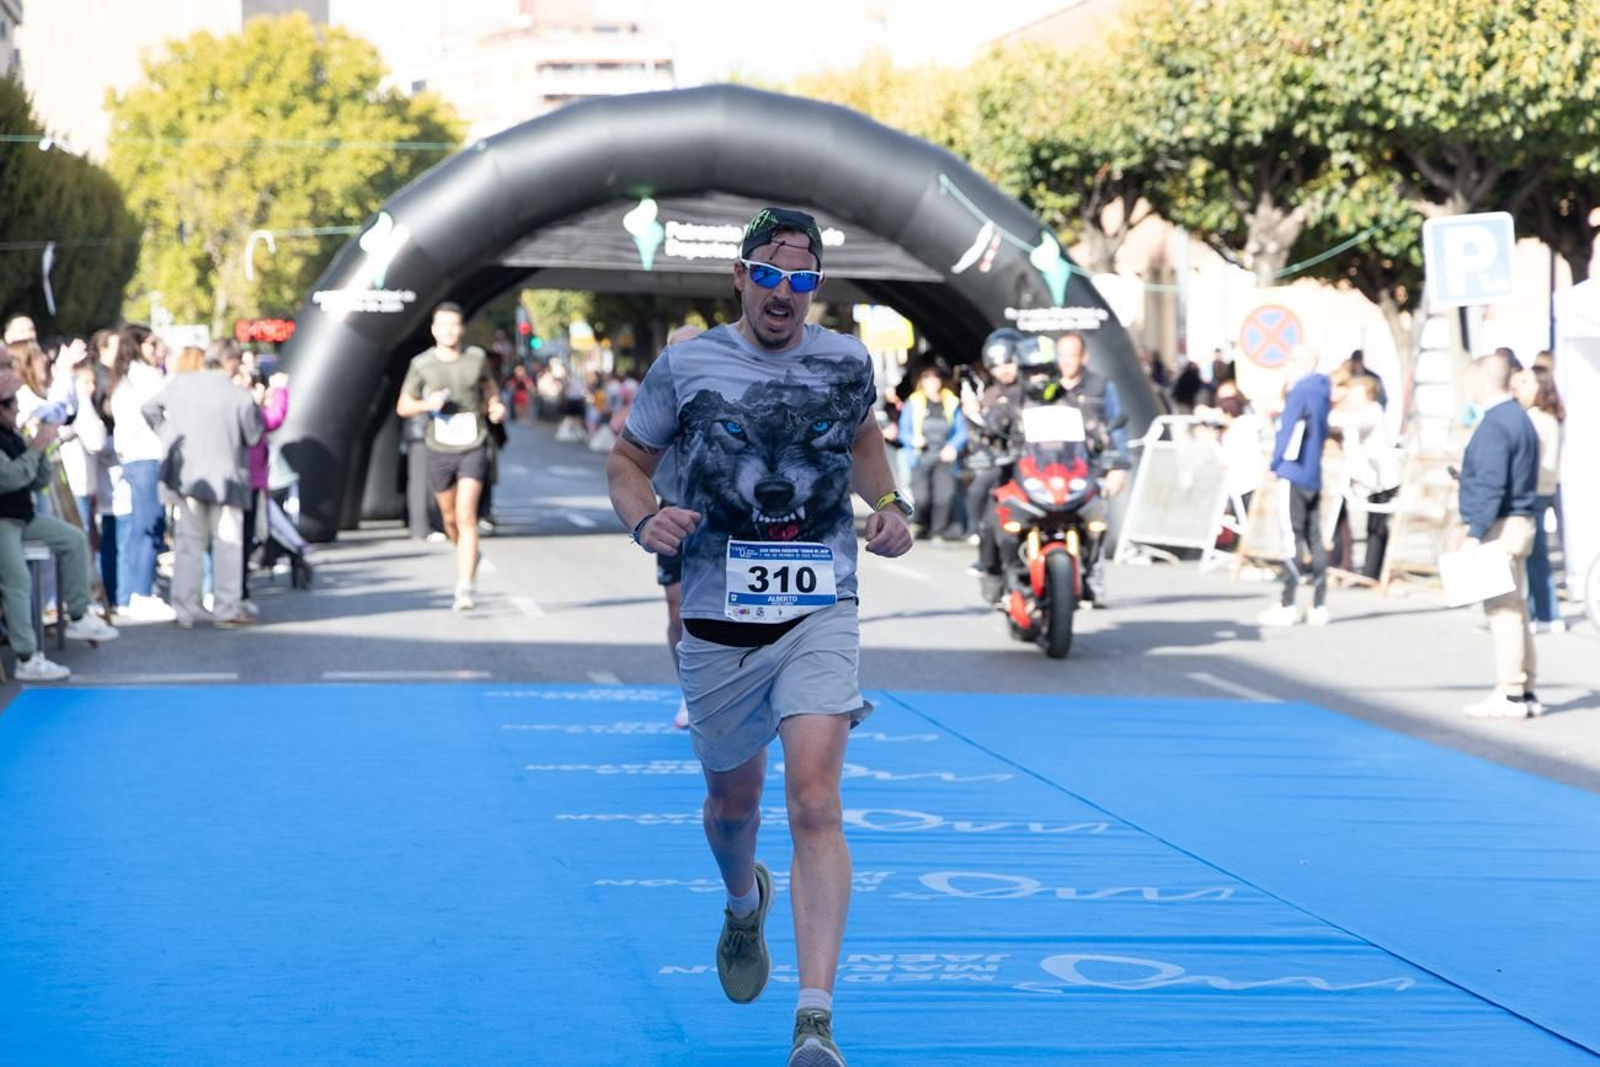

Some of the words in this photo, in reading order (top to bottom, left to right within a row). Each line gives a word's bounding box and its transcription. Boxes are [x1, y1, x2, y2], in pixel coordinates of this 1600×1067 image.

[1442, 226, 1498, 296] P
[748, 565, 817, 593] 310
[767, 595, 798, 603] ALBERTO
[659, 964, 1000, 975] MARTN
[770, 973, 995, 983] MEDA
